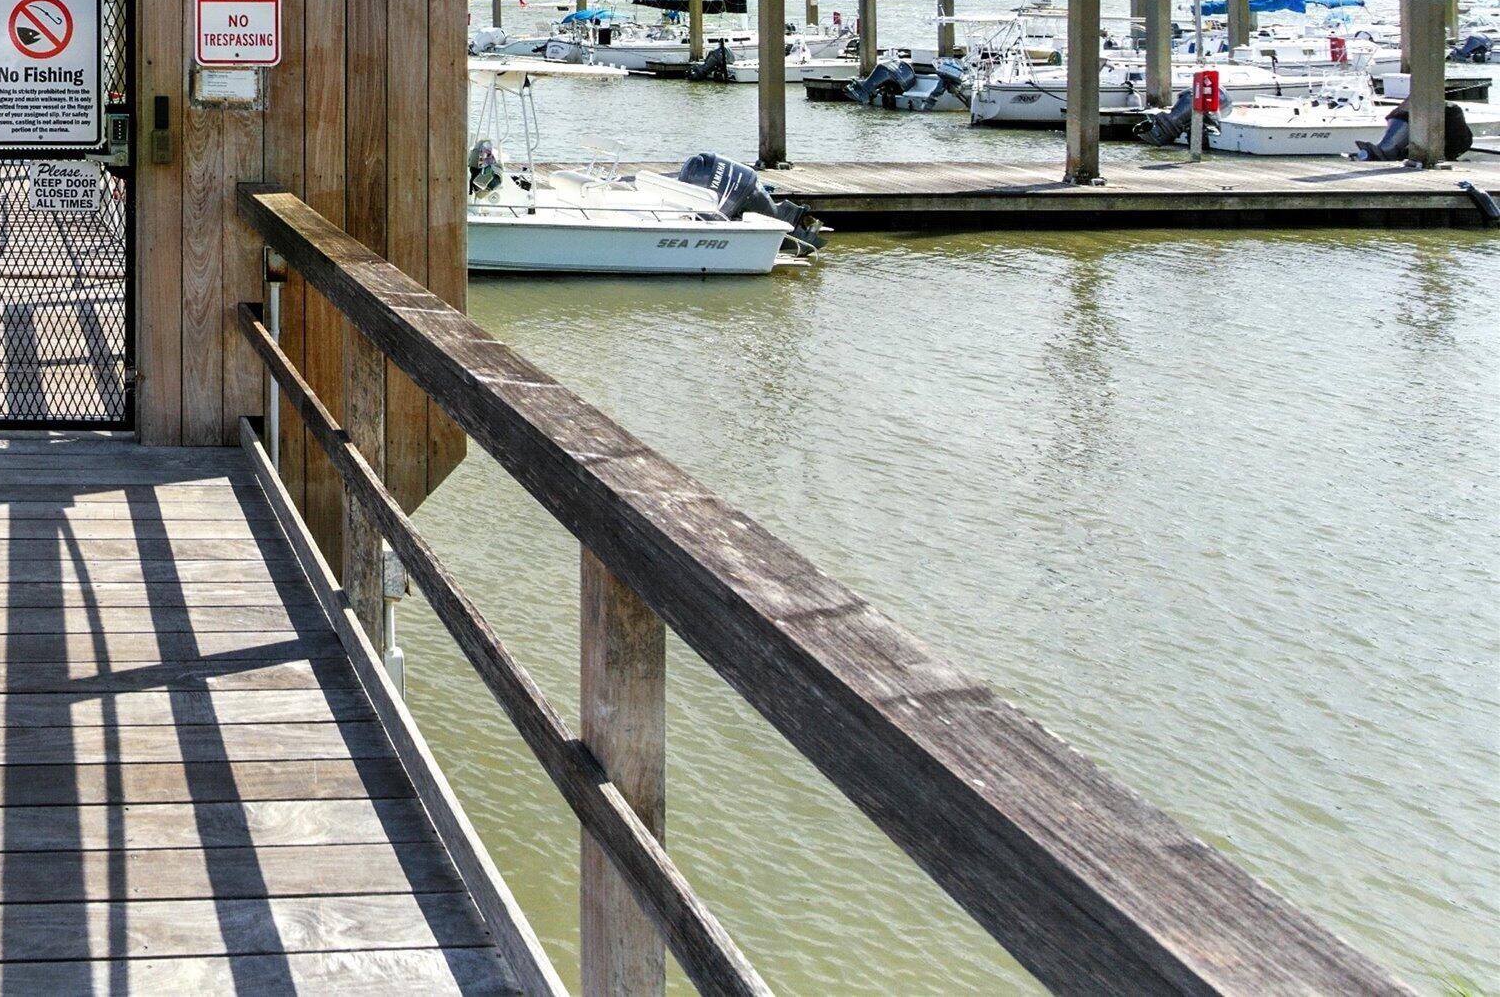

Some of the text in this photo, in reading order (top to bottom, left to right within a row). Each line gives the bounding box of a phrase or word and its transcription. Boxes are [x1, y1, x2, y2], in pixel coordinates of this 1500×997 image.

[228, 14, 249, 28] NO
[204, 33, 273, 47] TRESPASSING
[24, 67, 84, 86] Fishing
[37, 163, 94, 178] Please...
[710, 162, 726, 189] YAMAHA
[33, 178, 96, 188] KEEP DOOR
[35, 188, 95, 198] CLOSED AT
[36, 199, 93, 208] ALL TIMES
[657, 239, 729, 249] SEA PRO
